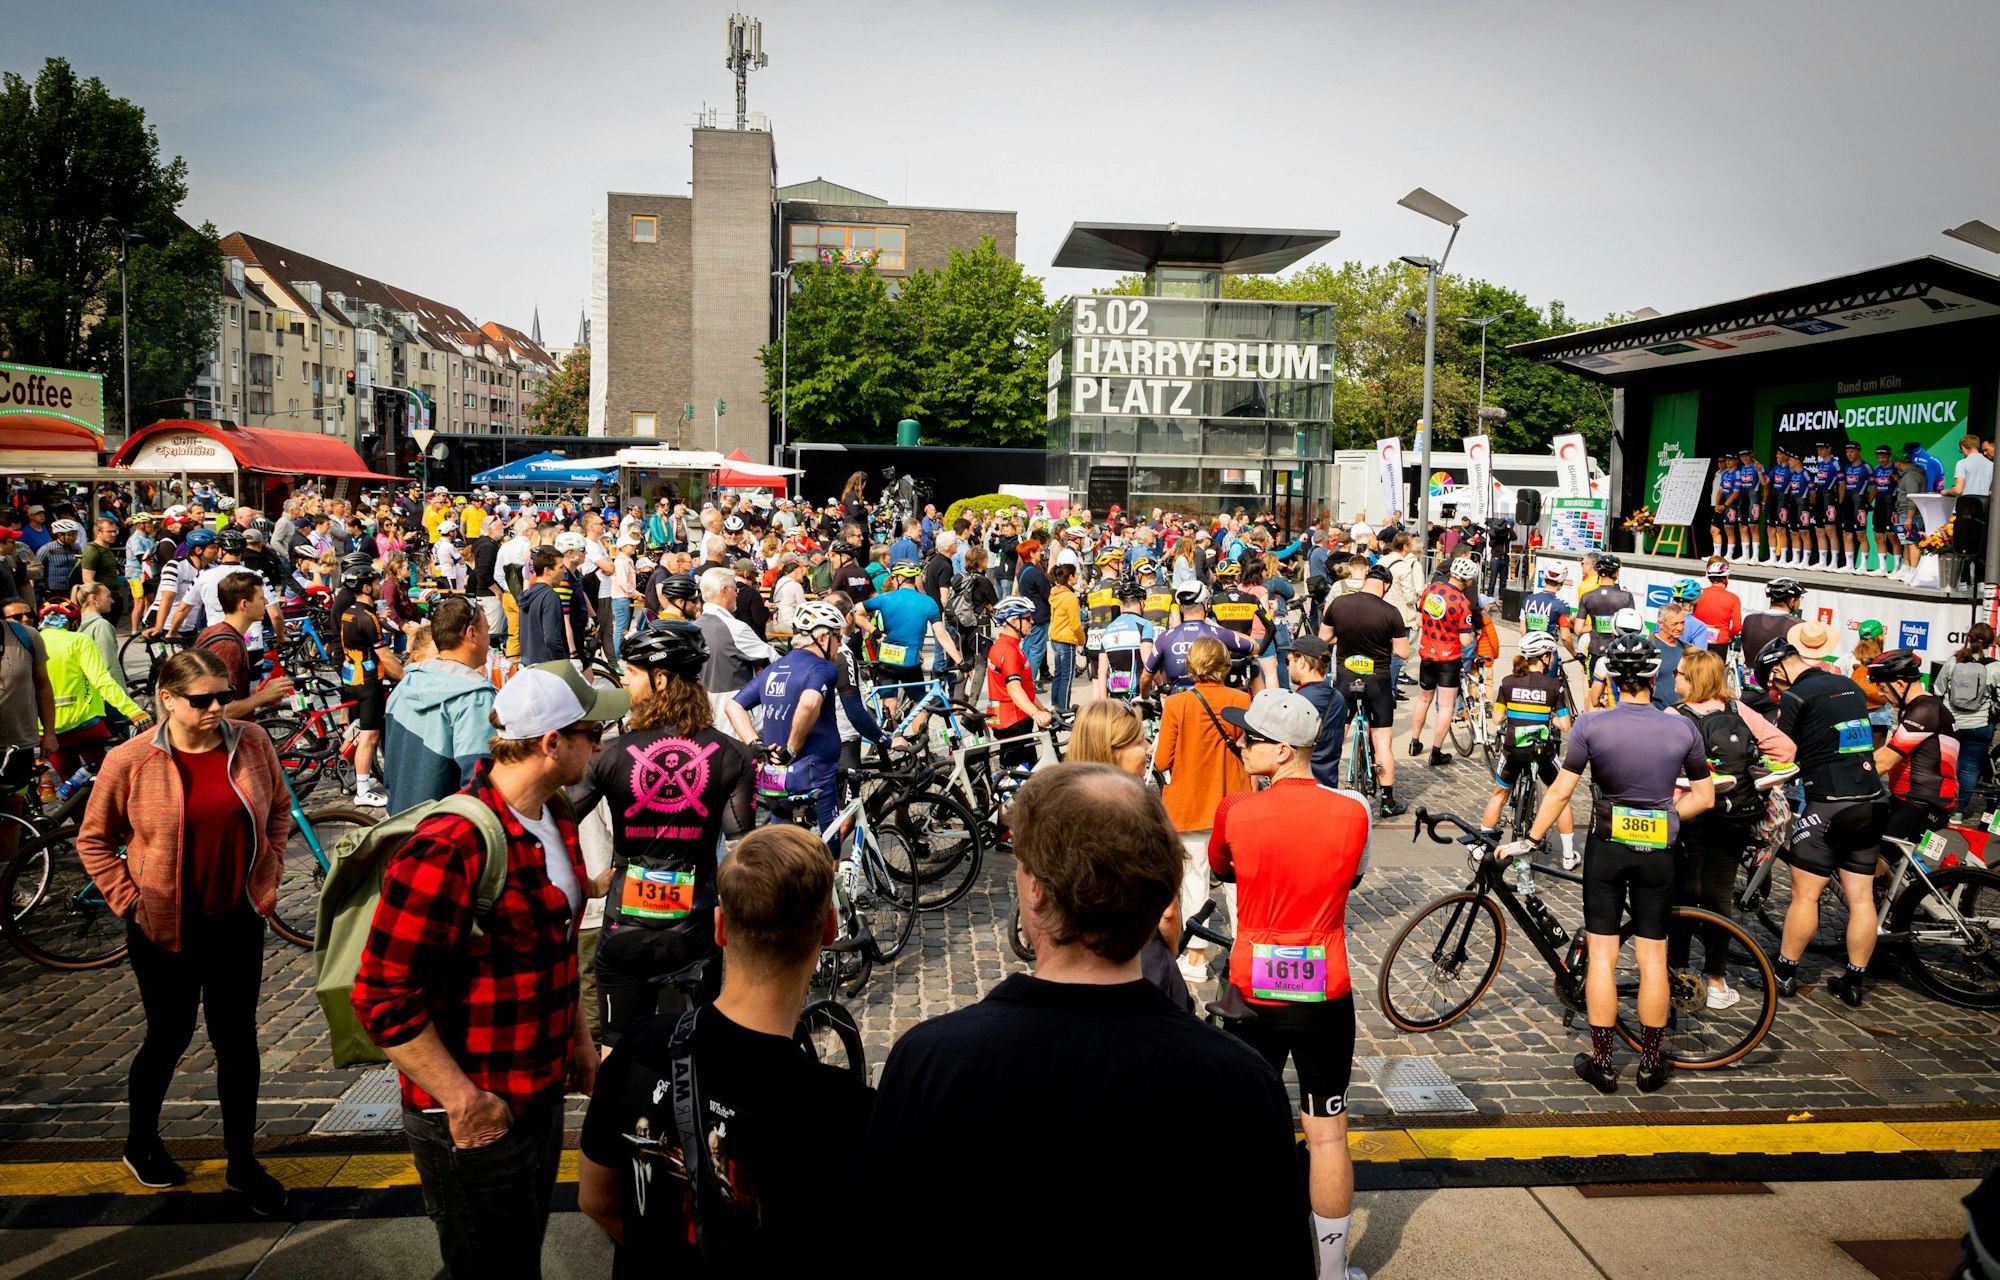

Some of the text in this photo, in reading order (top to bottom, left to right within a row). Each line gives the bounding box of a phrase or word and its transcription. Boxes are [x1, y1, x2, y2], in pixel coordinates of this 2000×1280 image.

[1076, 299, 1148, 335] 5.02
[1075, 338, 1332, 380] HARRY-BLUM-
[0, 370, 72, 409] Coffee
[1837, 375, 1901, 394] Rund um Köln
[1074, 377, 1193, 415] PLATZ
[1778, 400, 1958, 432] ALPECIN-DECEUNINCK
[1349, 659, 1369, 668] 3015
[769, 681, 785, 696] SVA
[1846, 728, 1868, 740] 3311
[625, 825, 655, 839] SUICIDAL
[1622, 817, 1657, 833] 3861
[636, 881, 680, 903] 1315
[642, 900, 671, 909] Dennis
[1265, 960, 1315, 980] 1619
[1274, 981, 1304, 990] Marcel
